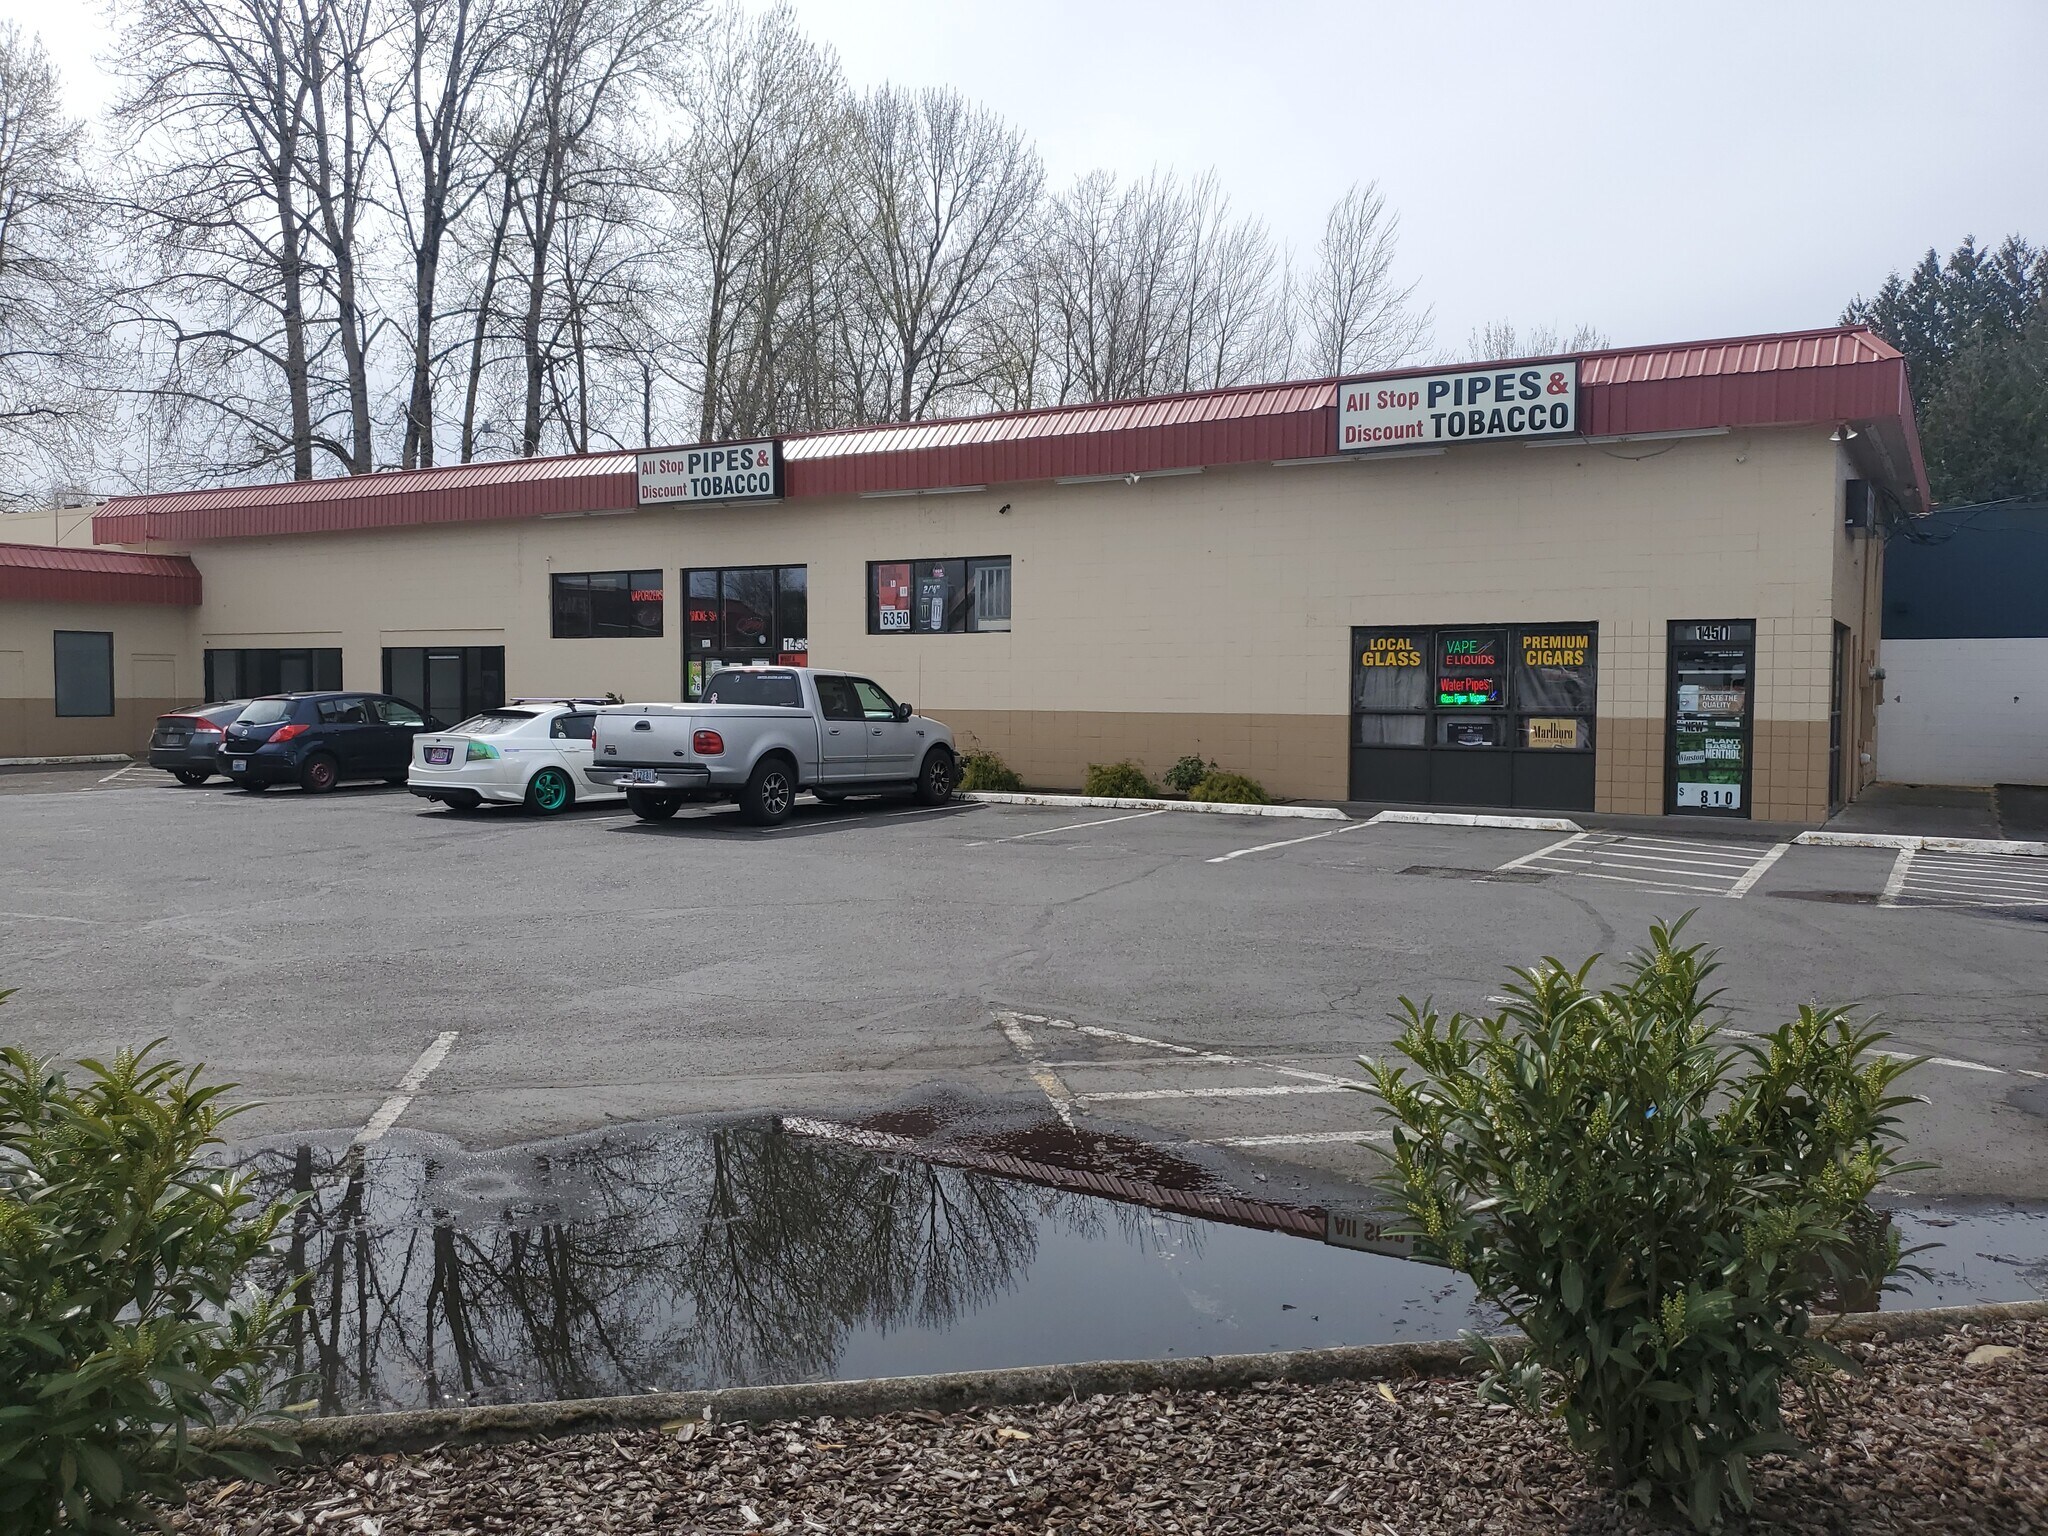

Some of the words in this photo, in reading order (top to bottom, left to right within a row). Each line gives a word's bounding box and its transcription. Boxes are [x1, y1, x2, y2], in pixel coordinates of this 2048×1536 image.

[1427, 371, 1541, 408] PIPES
[1346, 393, 1369, 412] All
[1377, 390, 1419, 410] Stop
[1430, 403, 1568, 438] TOBACCO
[1345, 420, 1423, 443] Discount
[641, 461, 655, 475] All
[659, 459, 684, 474] Stop
[688, 448, 753, 474] PIPES
[642, 483, 687, 499] Discount
[690, 472, 769, 497] TOBACCO
[1696, 626, 1729, 640] 1450
[1370, 638, 1413, 651] LOCAL
[1446, 640, 1477, 654] VAPE
[1522, 635, 1588, 649] PREMIUM
[1362, 651, 1421, 667] GLASS
[1454, 655, 1495, 665] LIQUIDS
[1526, 650, 1584, 666] CIGARS
[1440, 678, 1465, 691] Water
[1465, 678, 1489, 693] Pipes
[1724, 694, 1738, 702] THE
[1532, 722, 1573, 739] Marlboro
[1705, 749, 1740, 759] MENTHOL
[1678, 787, 1684, 796] $
